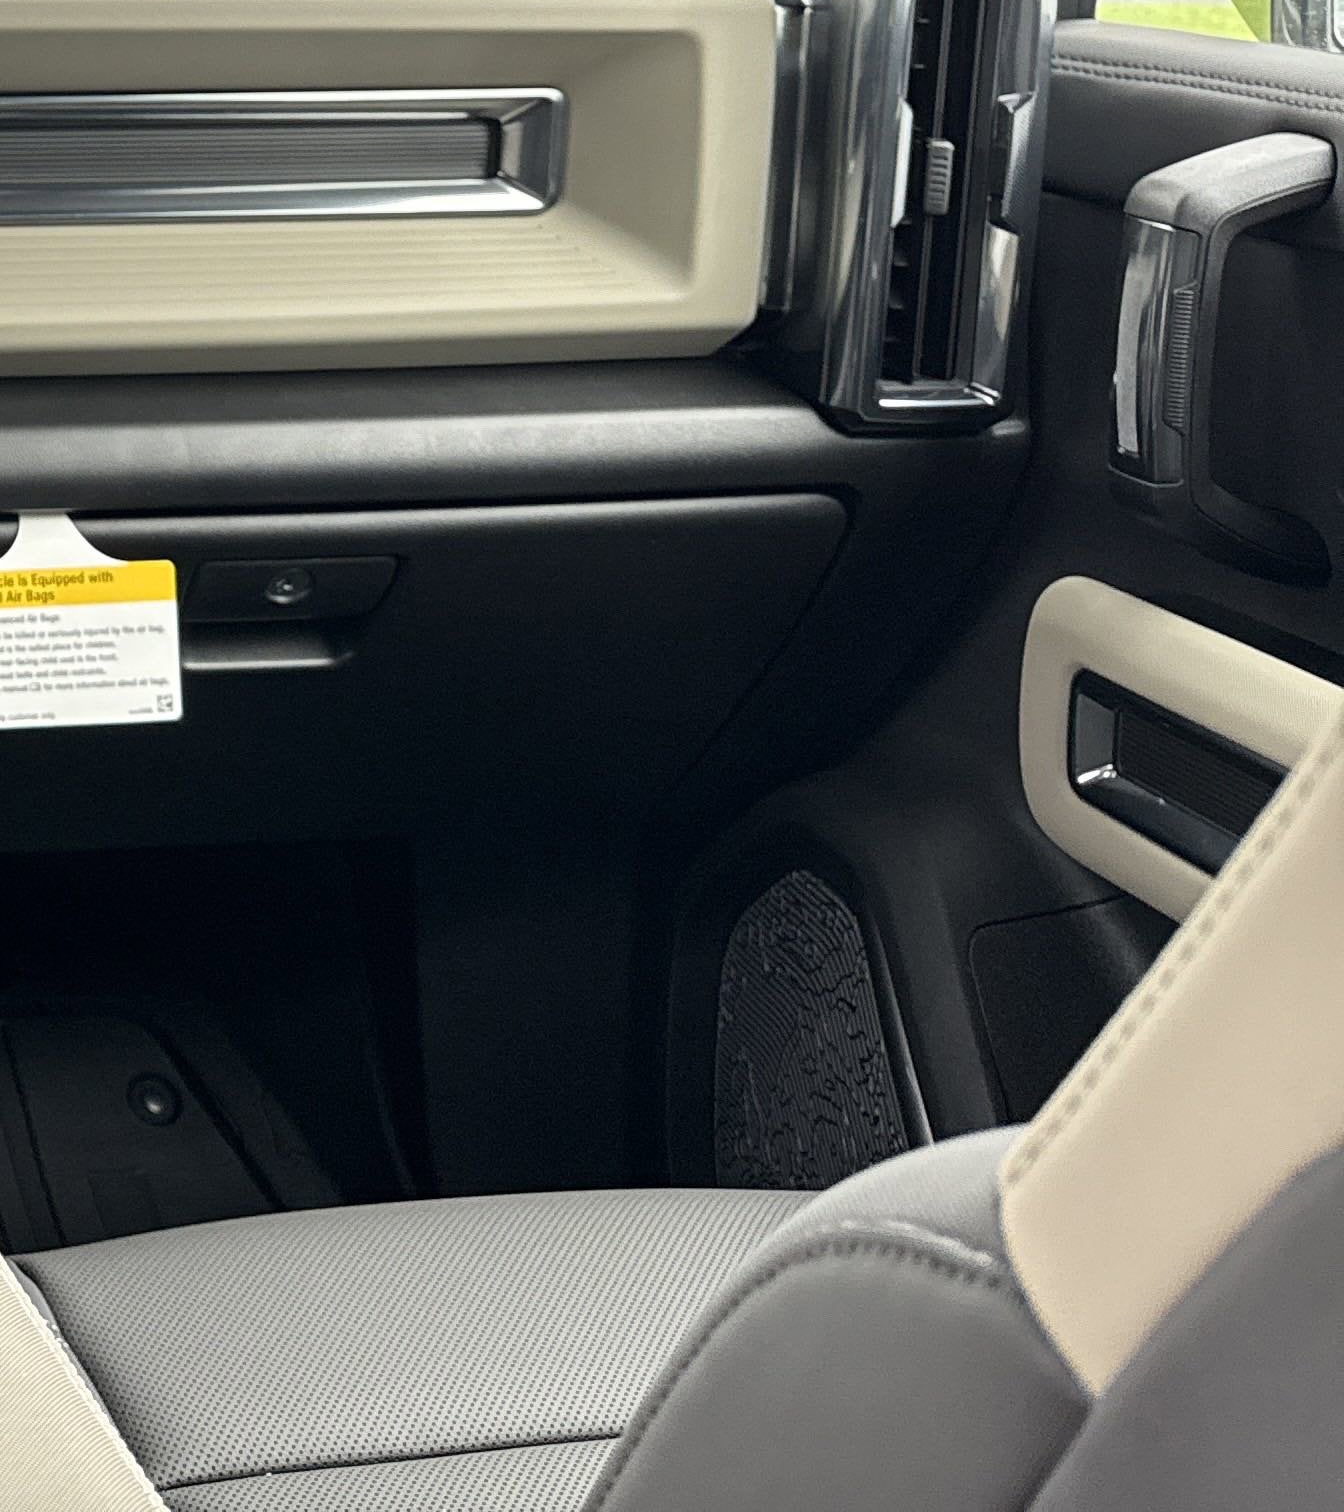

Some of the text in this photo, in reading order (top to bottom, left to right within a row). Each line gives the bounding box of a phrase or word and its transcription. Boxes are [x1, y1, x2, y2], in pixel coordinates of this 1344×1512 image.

[30, 571, 85, 587] Equipped
[87, 570, 114, 584] with
[5, 590, 22, 603] Air
[26, 590, 56, 603] Bags
